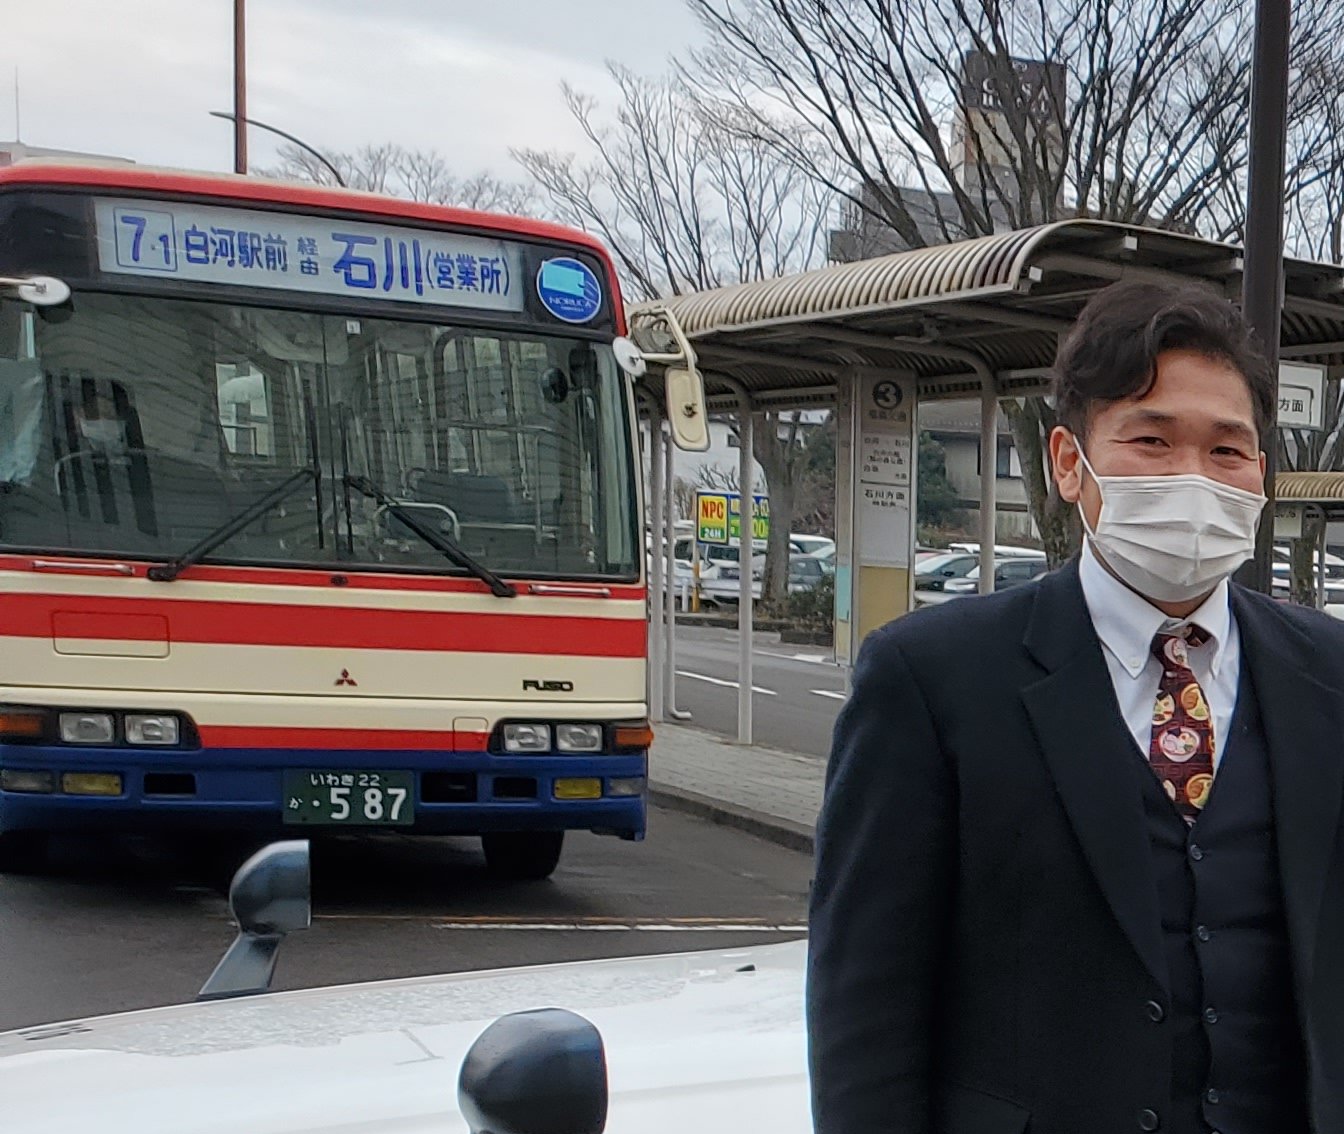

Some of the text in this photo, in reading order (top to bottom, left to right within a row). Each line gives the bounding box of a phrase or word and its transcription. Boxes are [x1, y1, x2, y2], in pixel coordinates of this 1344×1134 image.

[184, 223, 289, 274] 白河駅前
[298, 237, 321, 276] 経由
[702, 500, 724, 520] NPC
[704, 527, 721, 538] 24H
[522, 679, 574, 692] FUSO
[310, 772, 380, 786] いわき 22
